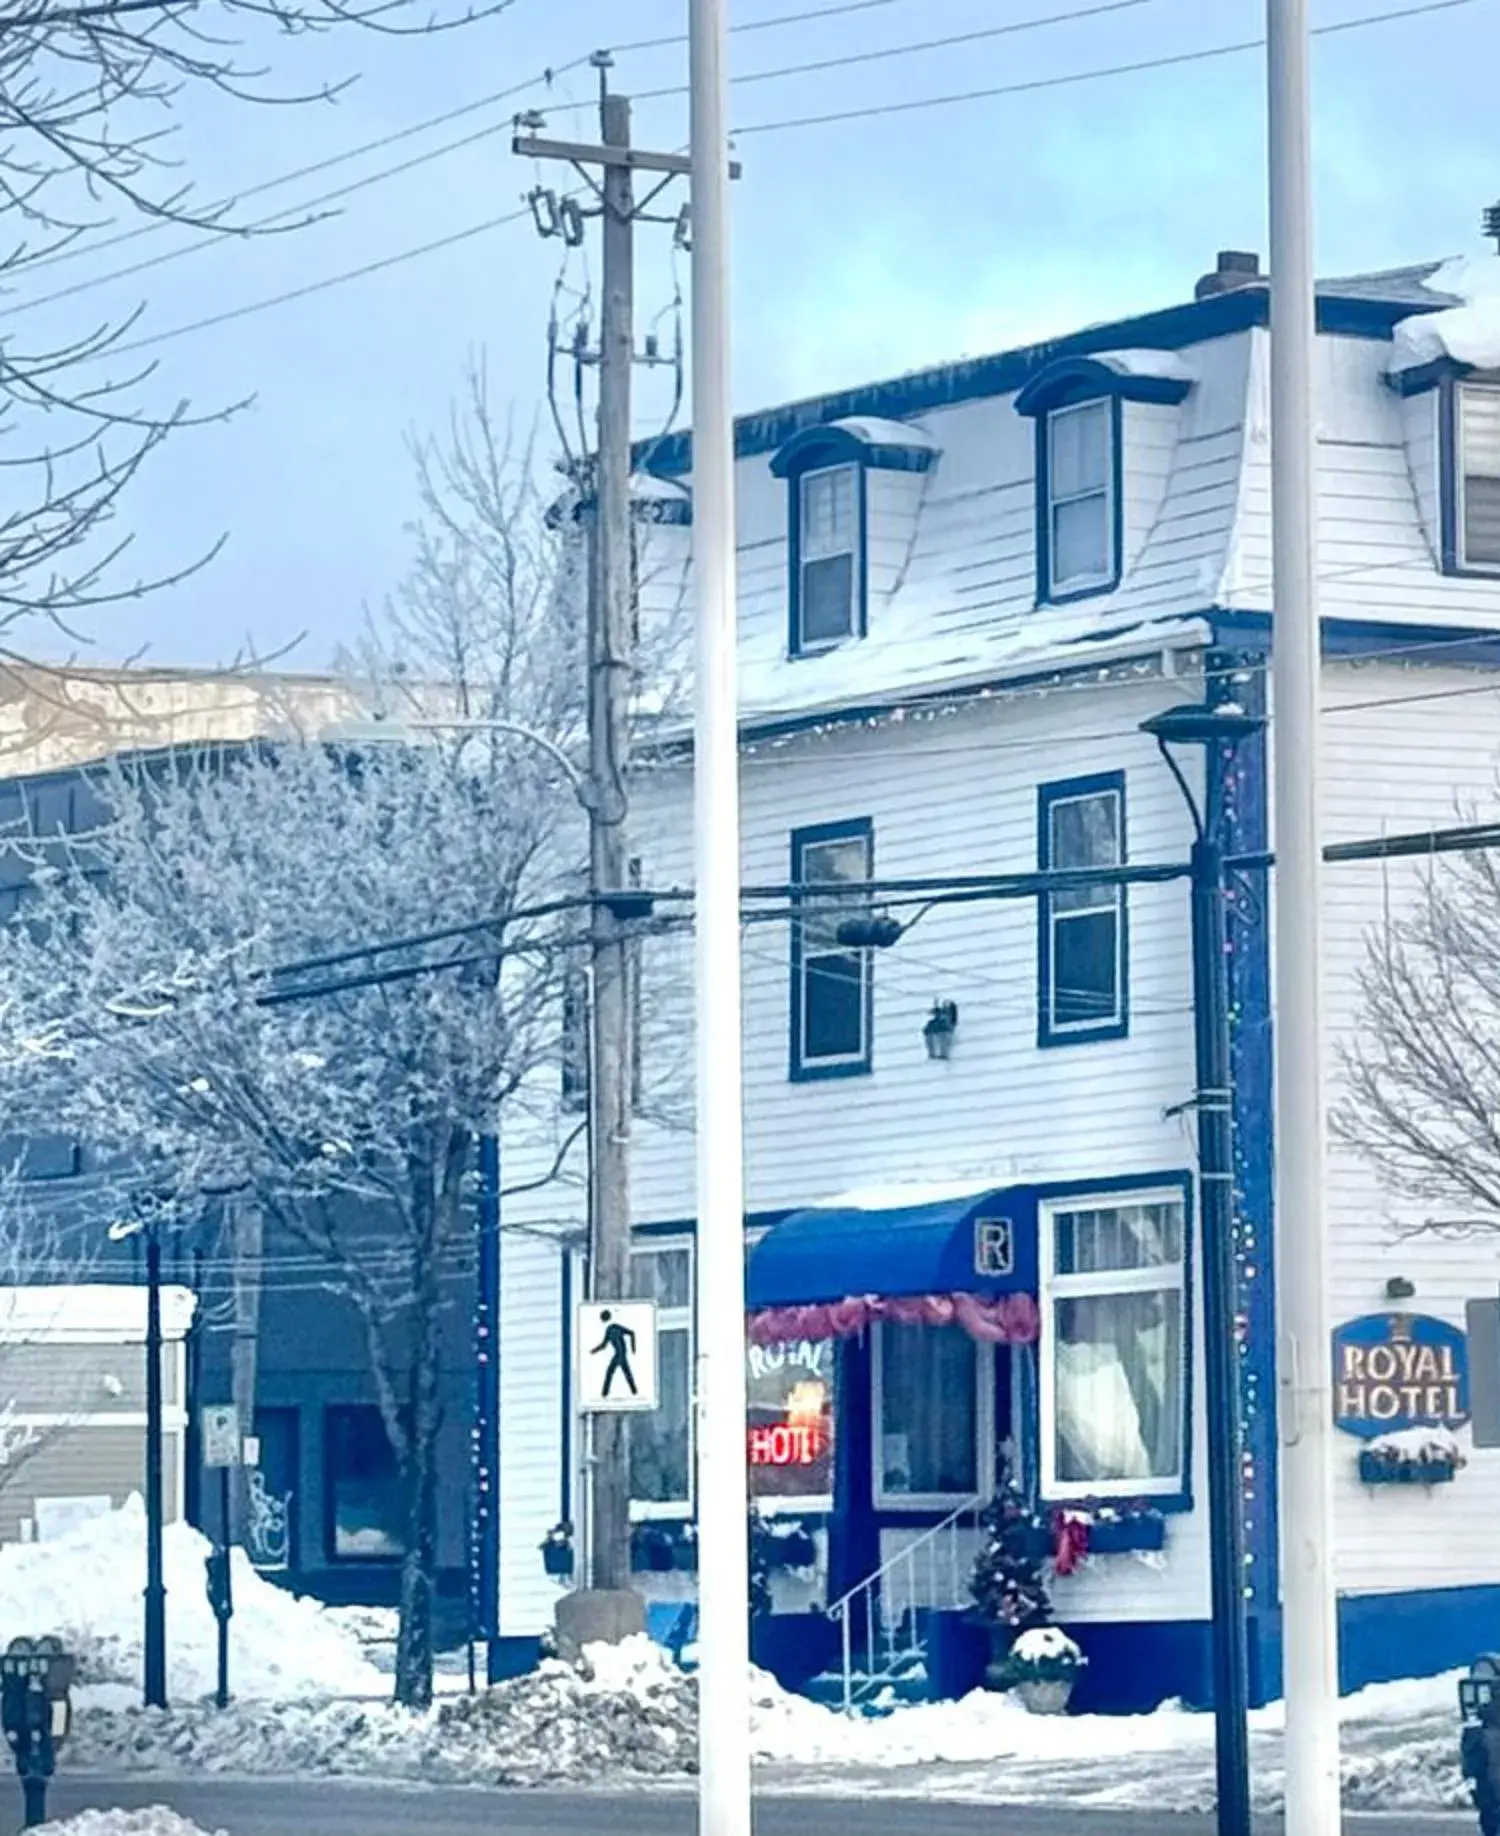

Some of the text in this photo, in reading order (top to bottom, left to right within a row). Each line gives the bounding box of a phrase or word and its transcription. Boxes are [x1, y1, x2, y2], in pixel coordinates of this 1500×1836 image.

[982, 1225, 1008, 1267] R
[1342, 1344, 1460, 1382] ROYAL
[1338, 1384, 1466, 1420] HOTEL
